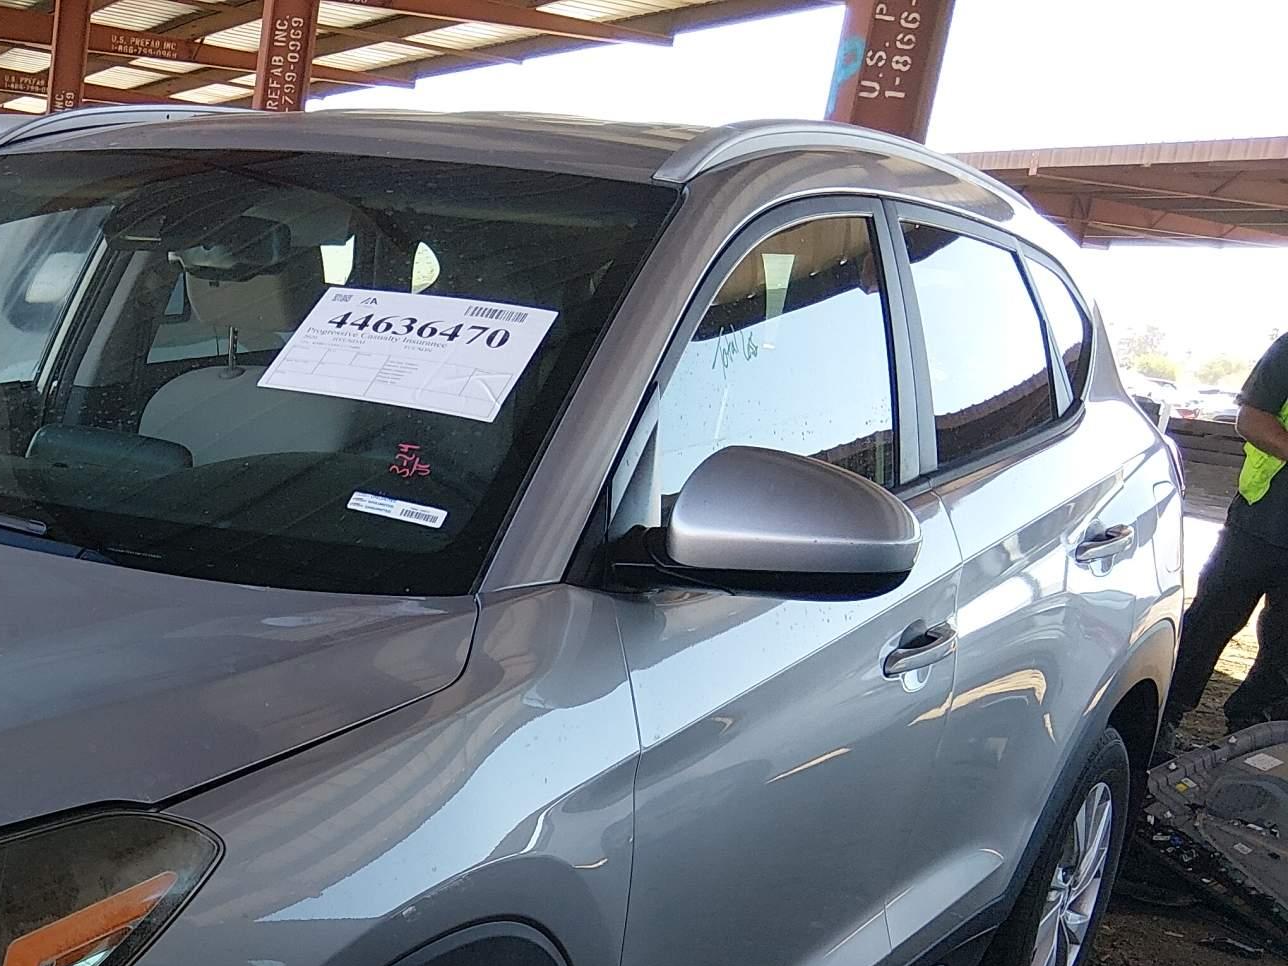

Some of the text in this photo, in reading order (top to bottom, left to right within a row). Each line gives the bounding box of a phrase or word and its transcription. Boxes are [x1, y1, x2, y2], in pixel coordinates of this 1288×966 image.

[266, 15, 290, 110] REFAB INC.
[858, 41, 890, 98] U.S.
[307, 327, 448, 348] Progressive Casualty Insurance
[327, 311, 511, 349] 44636470
